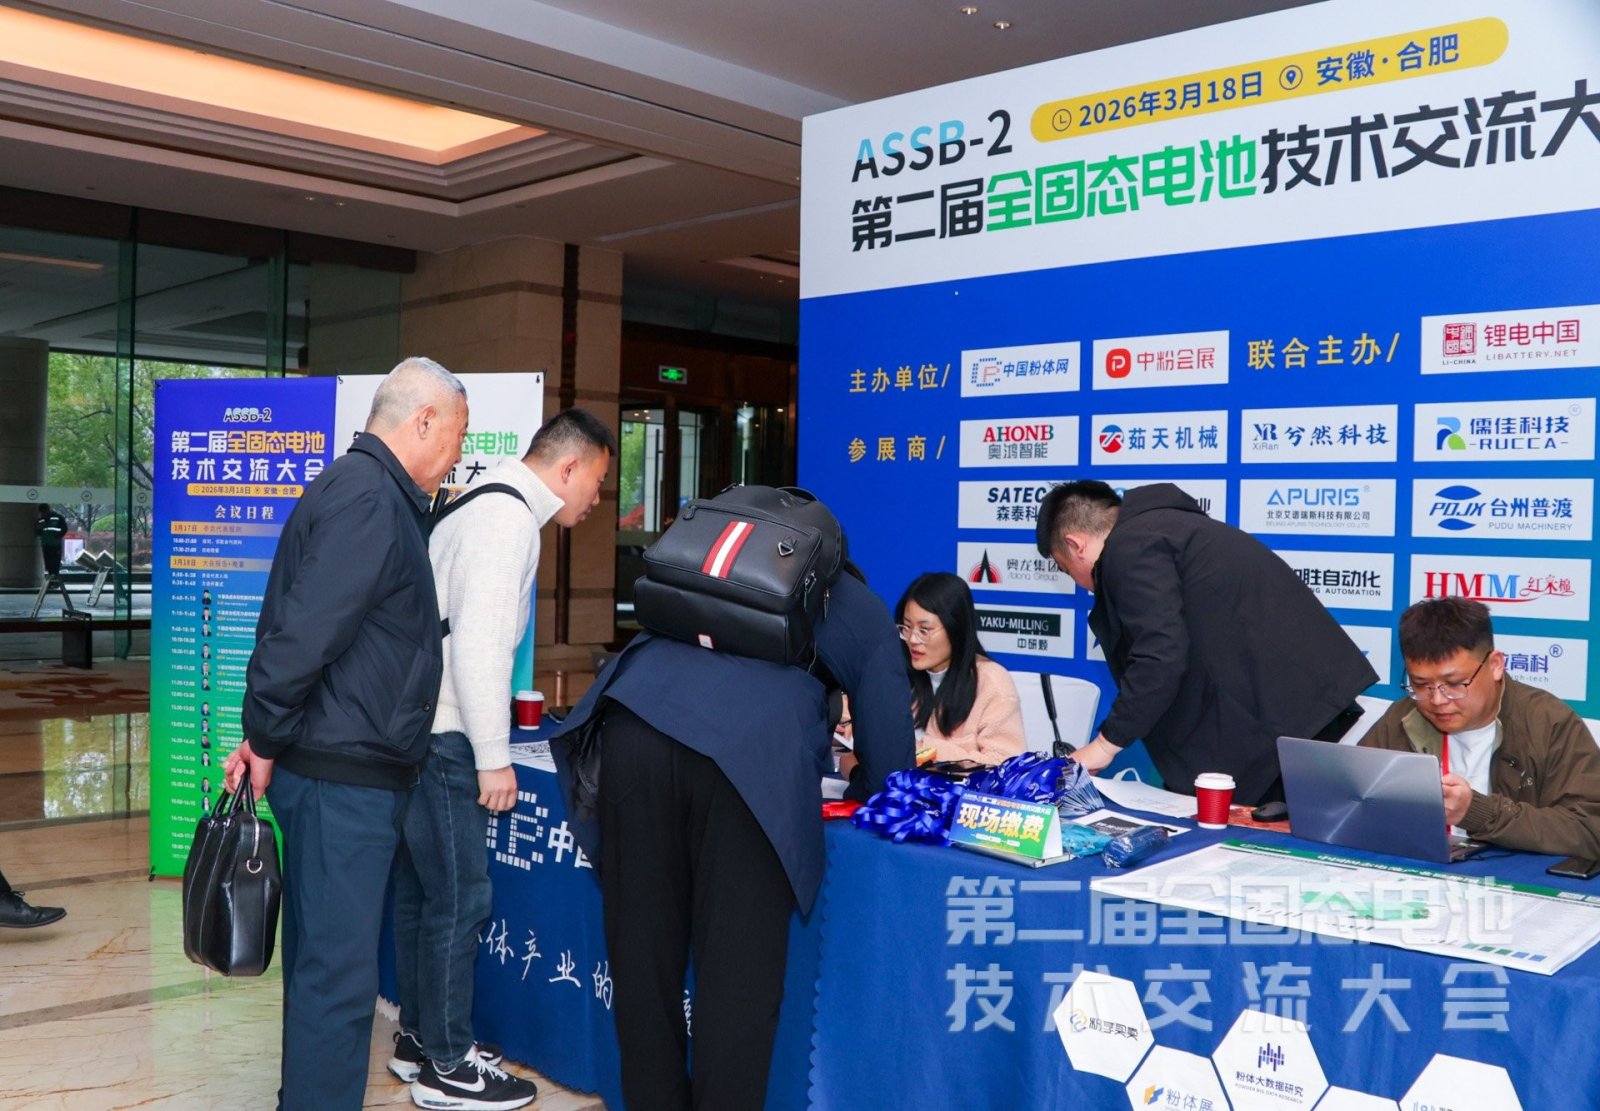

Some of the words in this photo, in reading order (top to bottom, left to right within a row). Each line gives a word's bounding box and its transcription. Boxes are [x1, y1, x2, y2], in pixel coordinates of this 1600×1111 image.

[1079, 70, 1262, 128] 2026年3月18日
[1316, 33, 1459, 86] 安徽·合肥
[851, 108, 1012, 182] ASSB-2
[851, 78, 1600, 252] 第二届全固态电池技术交流大
[1484, 319, 1580, 347] 锂电中国
[1137, 347, 1216, 372] 中粉会展
[1247, 332, 1400, 370] 联合主办/
[1486, 350, 1578, 361] LIBATTERY.NET
[849, 364, 951, 393] 主办单位/
[1003, 358, 1069, 378] 中国粉体网
[223, 407, 272, 422] ASSB-2
[1470, 416, 1569, 435] 儒佳科技
[171, 430, 325, 454] 第二届全固态电池
[983, 424, 1054, 442] AHONB
[1128, 425, 1218, 450] 茹天机械
[1284, 423, 1390, 447] 兮然科技
[988, 443, 1048, 460] 奥鸿智能
[1252, 442, 1279, 451] XiRan
[171, 458, 325, 482] 技术交流大会
[201, 485, 251, 495] 2026年3月18日
[1266, 488, 1360, 506] APURIS
[215, 504, 274, 520] 会议日程
[1490, 497, 1573, 519] 台州普渡
[1489, 521, 1513, 530] PUDU
[1517, 522, 1573, 531] MACHINERY
[1325, 588, 1381, 596] AUTOMATION
[1423, 571, 1521, 599] HMM
[979, 616, 1049, 632] YAKU-MILLING
[957, 802, 1045, 843] 现场缴费
[478, 918, 614, 1011] 体产业的
[1235, 1071, 1304, 1097] 粉体大数据研究
